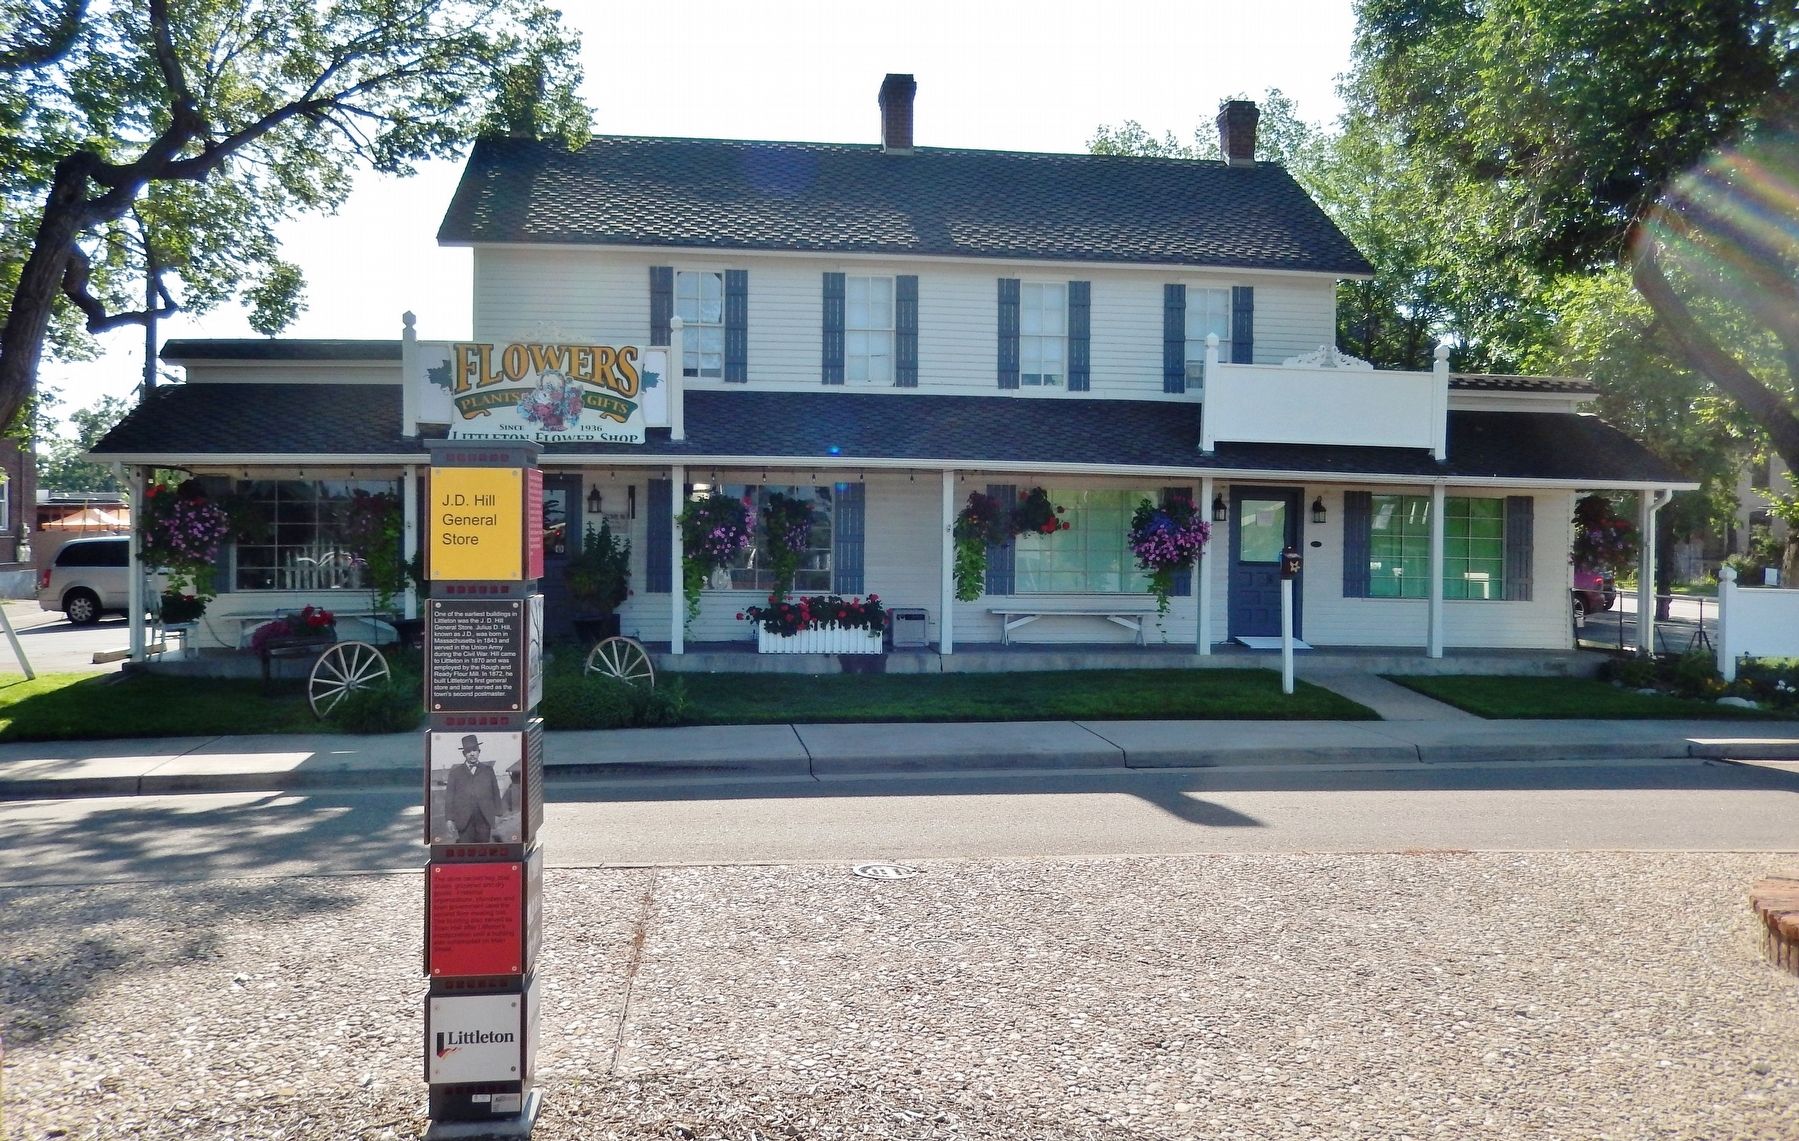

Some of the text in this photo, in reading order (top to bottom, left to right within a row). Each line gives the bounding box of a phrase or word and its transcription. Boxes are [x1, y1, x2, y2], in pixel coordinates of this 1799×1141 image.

[454, 343, 640, 399] FLOWERS
[461, 391, 520, 410] PLANTS
[586, 395, 628, 414] GIFTS
[499, 423, 603, 432] SINCE 1936
[600, 432, 638, 443] SHOP
[442, 494, 496, 507] J.D. Hill
[442, 513, 497, 526] General
[442, 533, 479, 546] Store
[447, 1030, 514, 1045] Littleton
